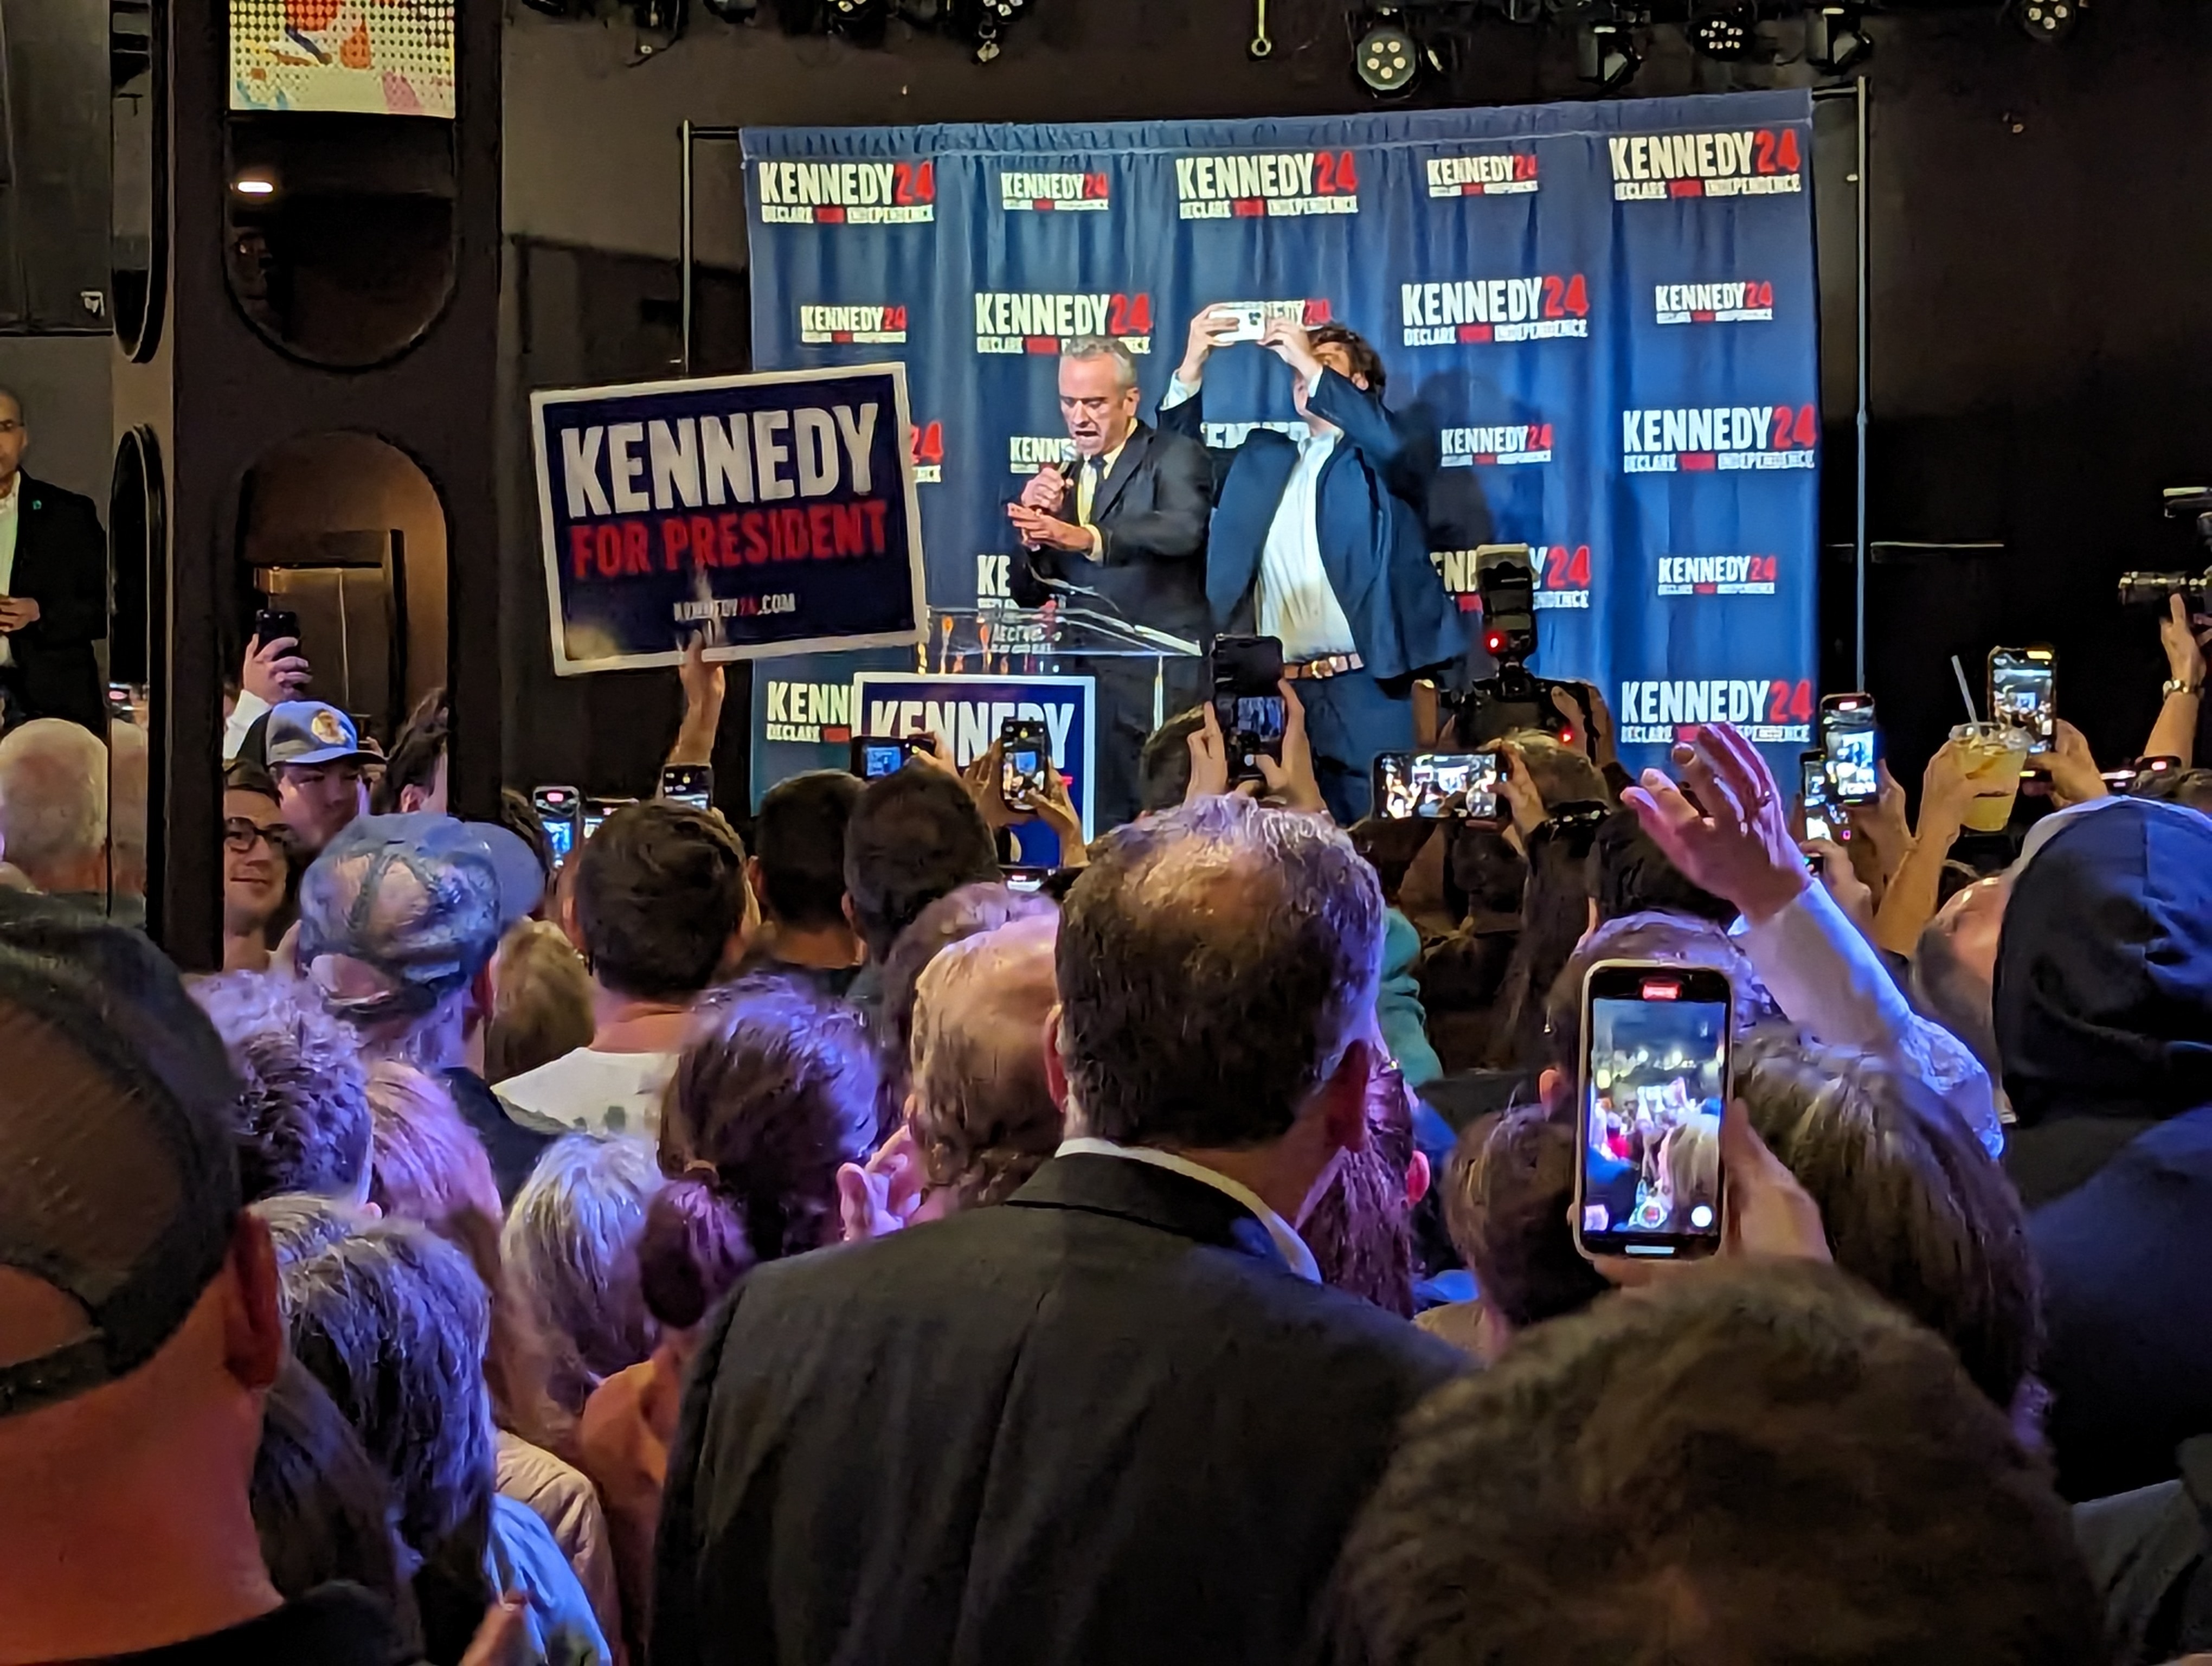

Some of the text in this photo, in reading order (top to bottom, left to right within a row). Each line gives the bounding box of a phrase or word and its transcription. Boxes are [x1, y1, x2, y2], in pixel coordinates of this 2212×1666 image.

[561, 403, 878, 518] KENNEDY
[571, 500, 887, 579] FOR PRESIDENT
